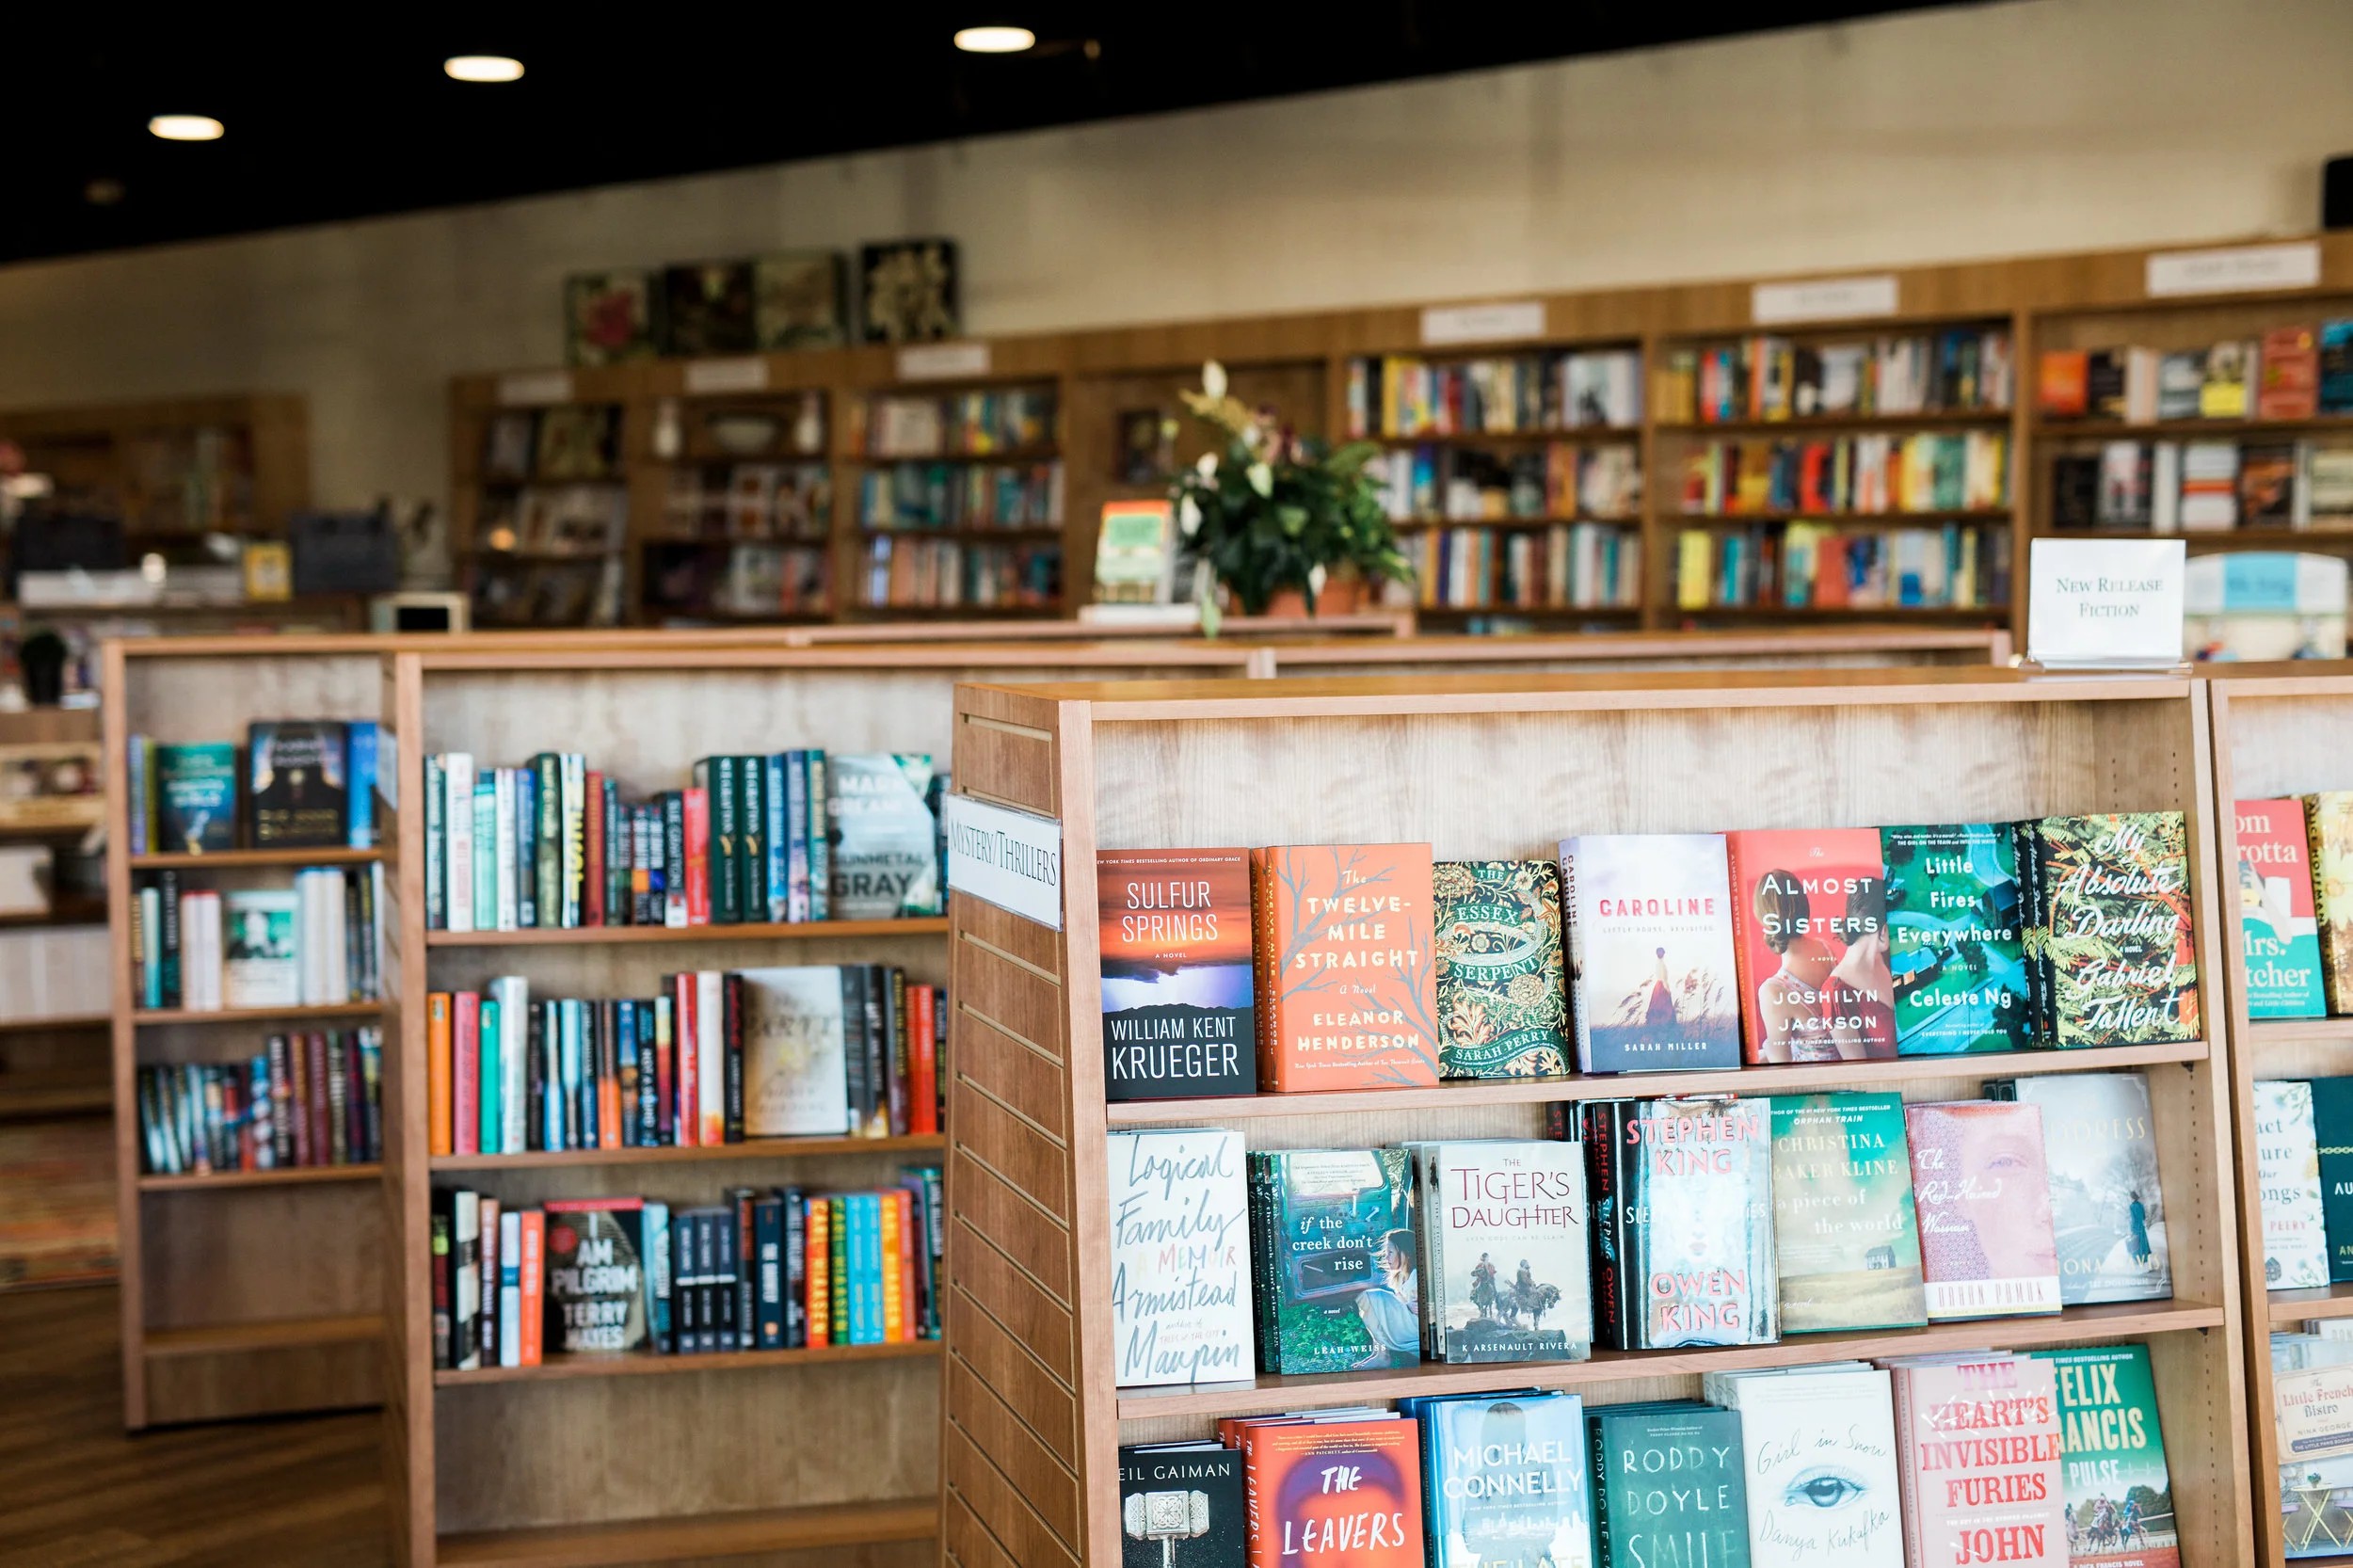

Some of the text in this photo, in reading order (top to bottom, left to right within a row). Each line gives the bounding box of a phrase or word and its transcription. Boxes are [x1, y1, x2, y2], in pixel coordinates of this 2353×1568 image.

[2057, 577, 2163, 593] NEW RELEASE
[2080, 603, 2139, 617] FICTION
[2236, 813, 2271, 834] om
[2095, 822, 2145, 865] My
[2238, 843, 2298, 864] rotta
[1343, 870, 1367, 884] The
[1478, 870, 1504, 881] THE
[1926, 856, 1974, 874] Little
[1762, 874, 1873, 895] ALMOST
[2053, 859, 2185, 904] Absolute
[2313, 849, 2325, 922] HOFFMAN
[1128, 881, 1211, 909] SULFUR
[1307, 896, 1411, 914] TWELVE-
[1930, 891, 1976, 908] Fires
[1457, 905, 1519, 925] ESSEX
[1600, 898, 1714, 917] CAROLINE
[1122, 914, 1218, 942] SPRINGS
[1328, 923, 1385, 941] MILE
[1762, 914, 1879, 935] SISTERS
[1897, 926, 2012, 947] Everywhere
[2062, 904, 2180, 946] Darling
[1295, 951, 1418, 969] STRAIGHT
[1454, 956, 1538, 982] SERPENT
[2065, 953, 2177, 1000] Gabriel
[2247, 965, 2312, 987] tcher
[1353, 984, 1376, 994] Novel
[1773, 989, 1878, 1005] JOSHILYN
[1910, 988, 2011, 1010] Celeste Ng
[1313, 1010, 1404, 1027] ELEANOR
[2082, 988, 2185, 1032] Tallent
[1112, 1016, 1236, 1041] WILLIAM KENT
[1778, 1016, 1877, 1032] JACKSON
[1298, 1033, 1419, 1051] HENDERSON
[1455, 1047, 1502, 1061] SARAH
[1506, 1031, 1548, 1050] PERRY
[1625, 1042, 1707, 1052] SARAH MILLER
[1112, 1044, 1240, 1079] KRUEGER
[1626, 1114, 1758, 1145] STEPHEN
[1794, 1116, 1832, 1126] ORPHAN
[1598, 1112, 1609, 1192] STEPHEN
[1778, 1133, 1884, 1152] CHRISTINA
[1128, 1134, 1234, 1201] Logical
[1503, 1159, 1521, 1167] THE
[1656, 1149, 1732, 1176] KING
[1841, 1159, 1898, 1177] KLINE
[1917, 1148, 1945, 1170] The
[1450, 1169, 1571, 1204] TIGER'S
[1918, 1176, 2003, 1205] Red-Haired
[2261, 1188, 2301, 1205] ongs
[1792, 1192, 1842, 1212] piece
[1849, 1189, 1866, 1206] of
[1115, 1189, 1246, 1252] Family
[1300, 1216, 1343, 1234] if the
[1451, 1204, 1579, 1229] DAUGHTER
[1602, 1197, 1612, 1259] SLEEPING
[1815, 1216, 1903, 1234] the world
[1922, 1211, 1969, 1234] Woman
[577, 1238, 613, 1266] AM
[1292, 1236, 1373, 1251] creek don't
[1335, 1257, 1364, 1271] rise
[552, 1265, 637, 1294] PILGRIM
[1651, 1270, 1745, 1297] OWEN
[1112, 1262, 1238, 1323] Armistead
[1607, 1267, 1615, 1324] OWEN
[564, 1301, 628, 1325] TERRY
[1661, 1304, 1739, 1332] KING
[1124, 1320, 1240, 1384] Maupin
[1314, 1344, 1386, 1354] LEAH WEISS
[1462, 1340, 1577, 1352] K ARSENAULT RIVERA
[1957, 1362, 2018, 1392] THE
[2282, 1384, 2353, 1407] Little French
[1930, 1396, 2051, 1432] HEART'S
[2304, 1404, 2338, 1417] Bistro
[2058, 1407, 2147, 1453] ANCIS
[2319, 1422, 2351, 1432] GEORGE
[1453, 1440, 1572, 1469] MICHAEL
[1623, 1447, 1730, 1474] RODDY
[1757, 1423, 1887, 1475] Girl in Snow
[1922, 1432, 2062, 1472] INVISIBLE
[1118, 1463, 1230, 1481] EIL GAIMAN
[1321, 1465, 1363, 1495] THE
[1443, 1469, 1583, 1498] CONNELLY
[2069, 1459, 2121, 1487] PULSE
[1627, 1484, 1729, 1516] DOYLE
[1945, 1473, 2047, 1508] FURIES
[1282, 1512, 1405, 1555] LEAVERS
[1760, 1516, 1817, 1551] Danya
[1956, 1525, 2044, 1565] JOHN
